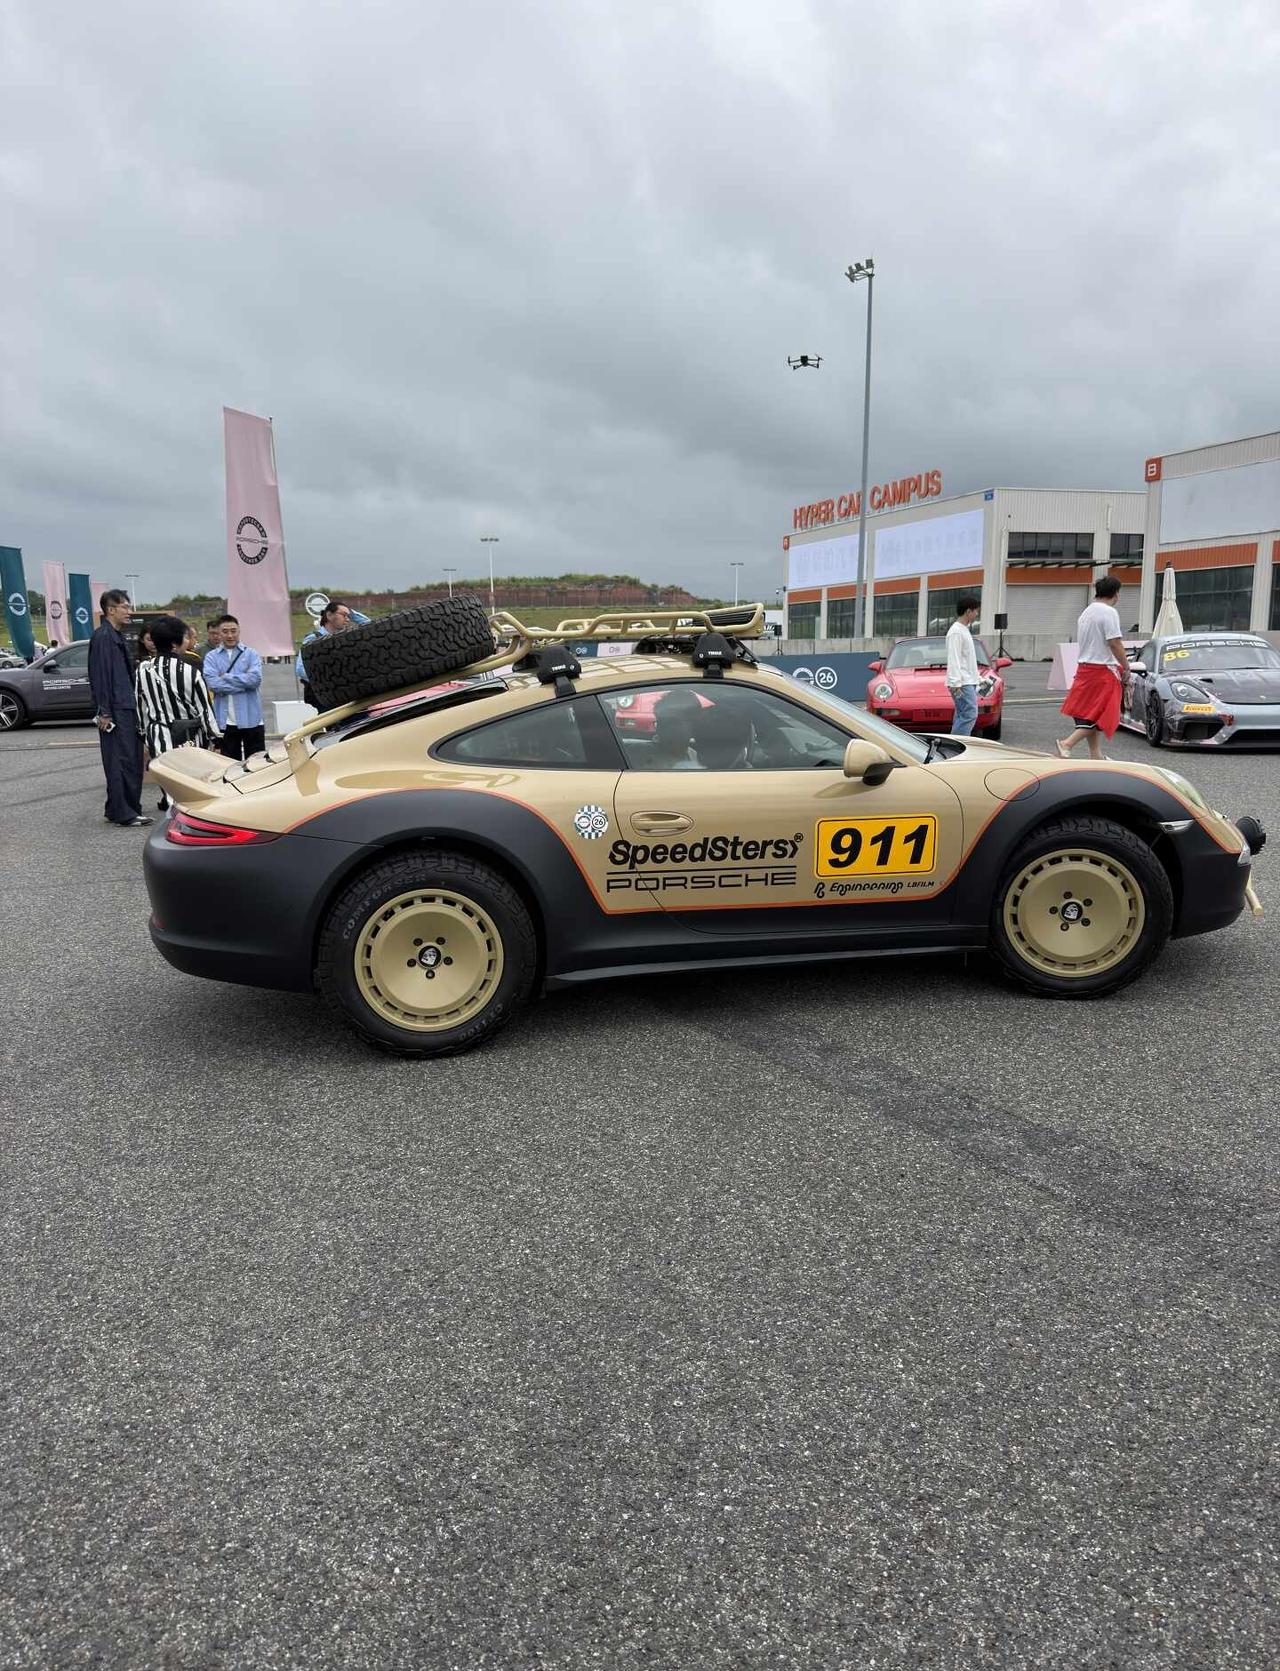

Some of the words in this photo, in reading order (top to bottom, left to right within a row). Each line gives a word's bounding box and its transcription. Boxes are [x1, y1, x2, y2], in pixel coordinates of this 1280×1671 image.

[1147, 464, 1157, 476] B
[794, 500, 834, 529] HYPER
[870, 470, 941, 510] CAMPUS
[1167, 640, 1267, 651] PORSCHE
[1163, 649, 1190, 661] 86
[820, 672, 834, 683] 26
[594, 818, 604, 826] 26
[827, 824, 930, 869] 911
[606, 872, 797, 893] PORSCHE
